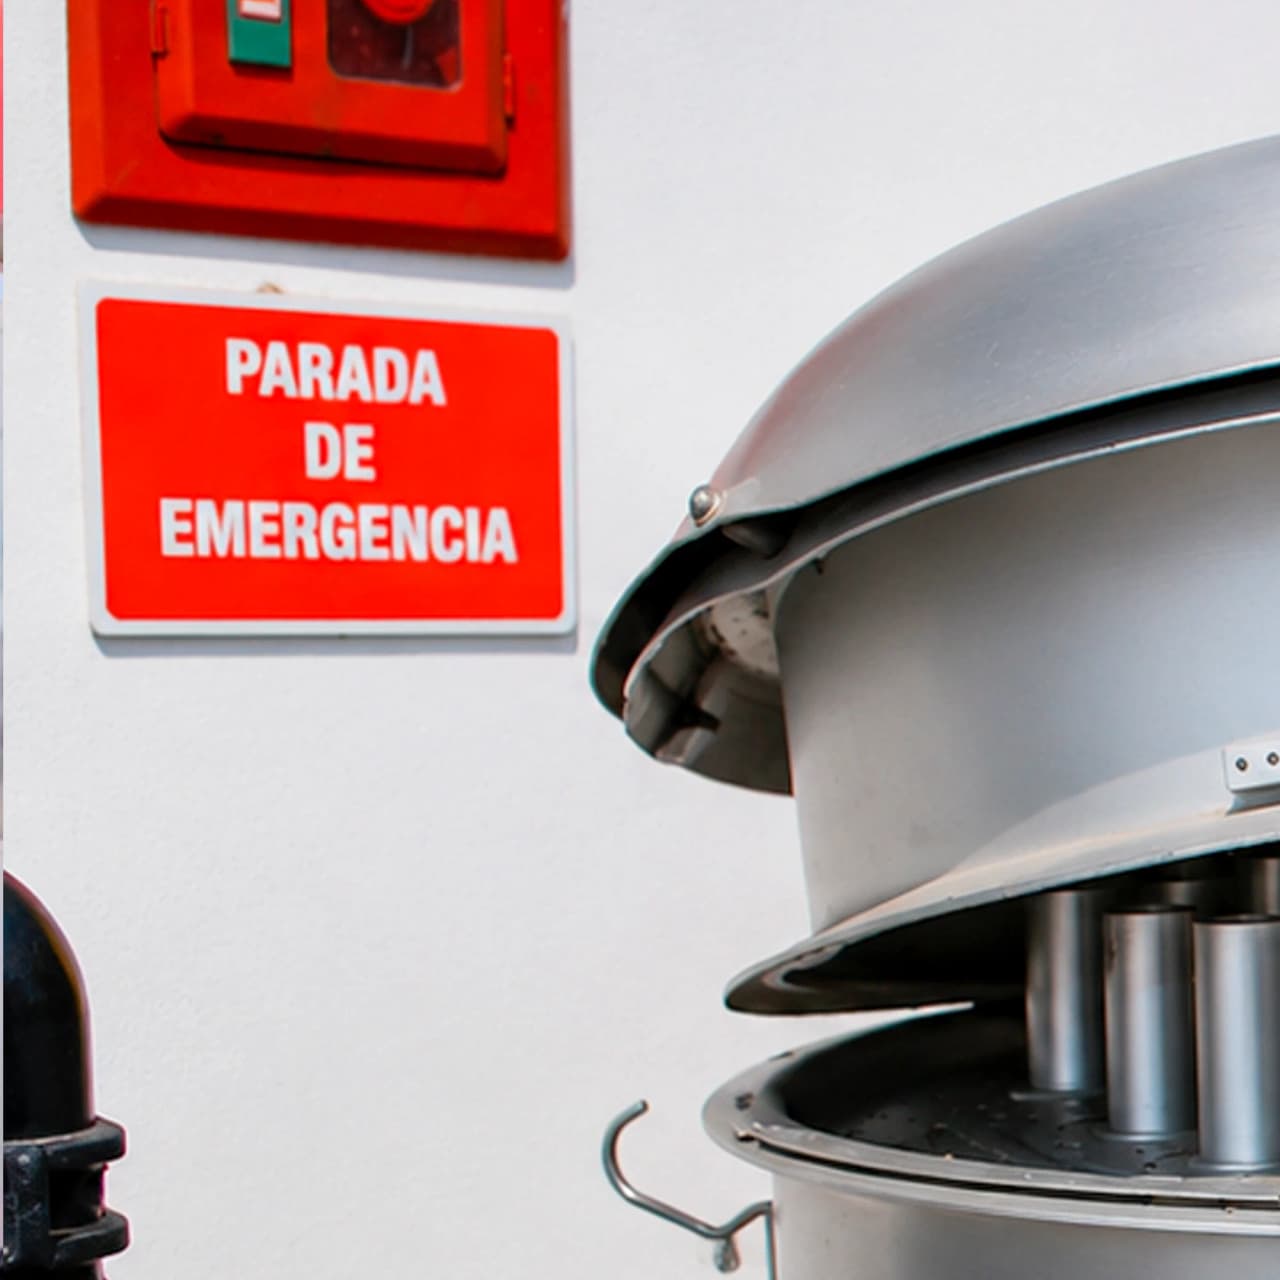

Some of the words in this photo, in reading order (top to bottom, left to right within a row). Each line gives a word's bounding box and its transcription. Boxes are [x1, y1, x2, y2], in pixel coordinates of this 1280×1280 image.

[226, 337, 447, 406] PARADA
[304, 421, 376, 482] DE
[160, 497, 518, 563] EMERGENCIA
